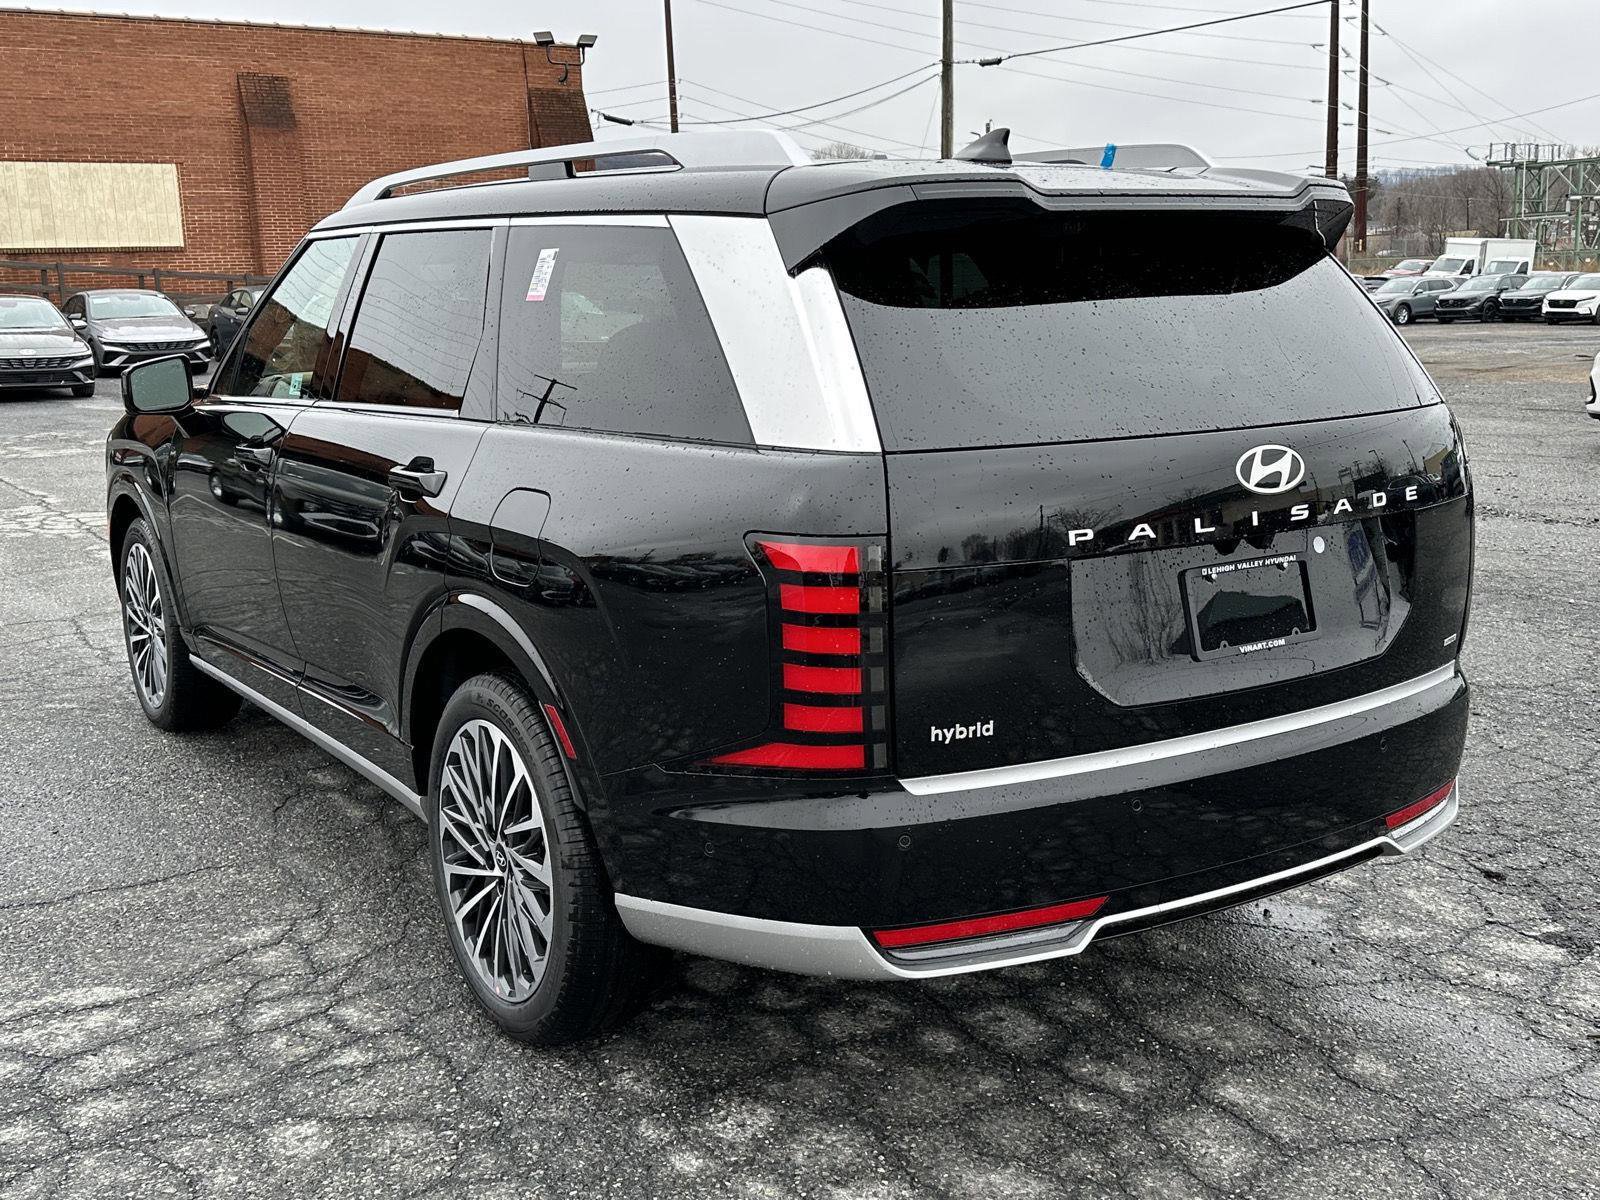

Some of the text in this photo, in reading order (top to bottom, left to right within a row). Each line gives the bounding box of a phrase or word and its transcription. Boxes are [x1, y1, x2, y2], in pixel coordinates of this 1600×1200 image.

[1068, 486, 1418, 546] PALISADE
[1208, 555, 1297, 574] LEHIGH VALLEY HYUNDAI
[1239, 638, 1286, 653] VINART.COM
[930, 720, 994, 744] hybrid
